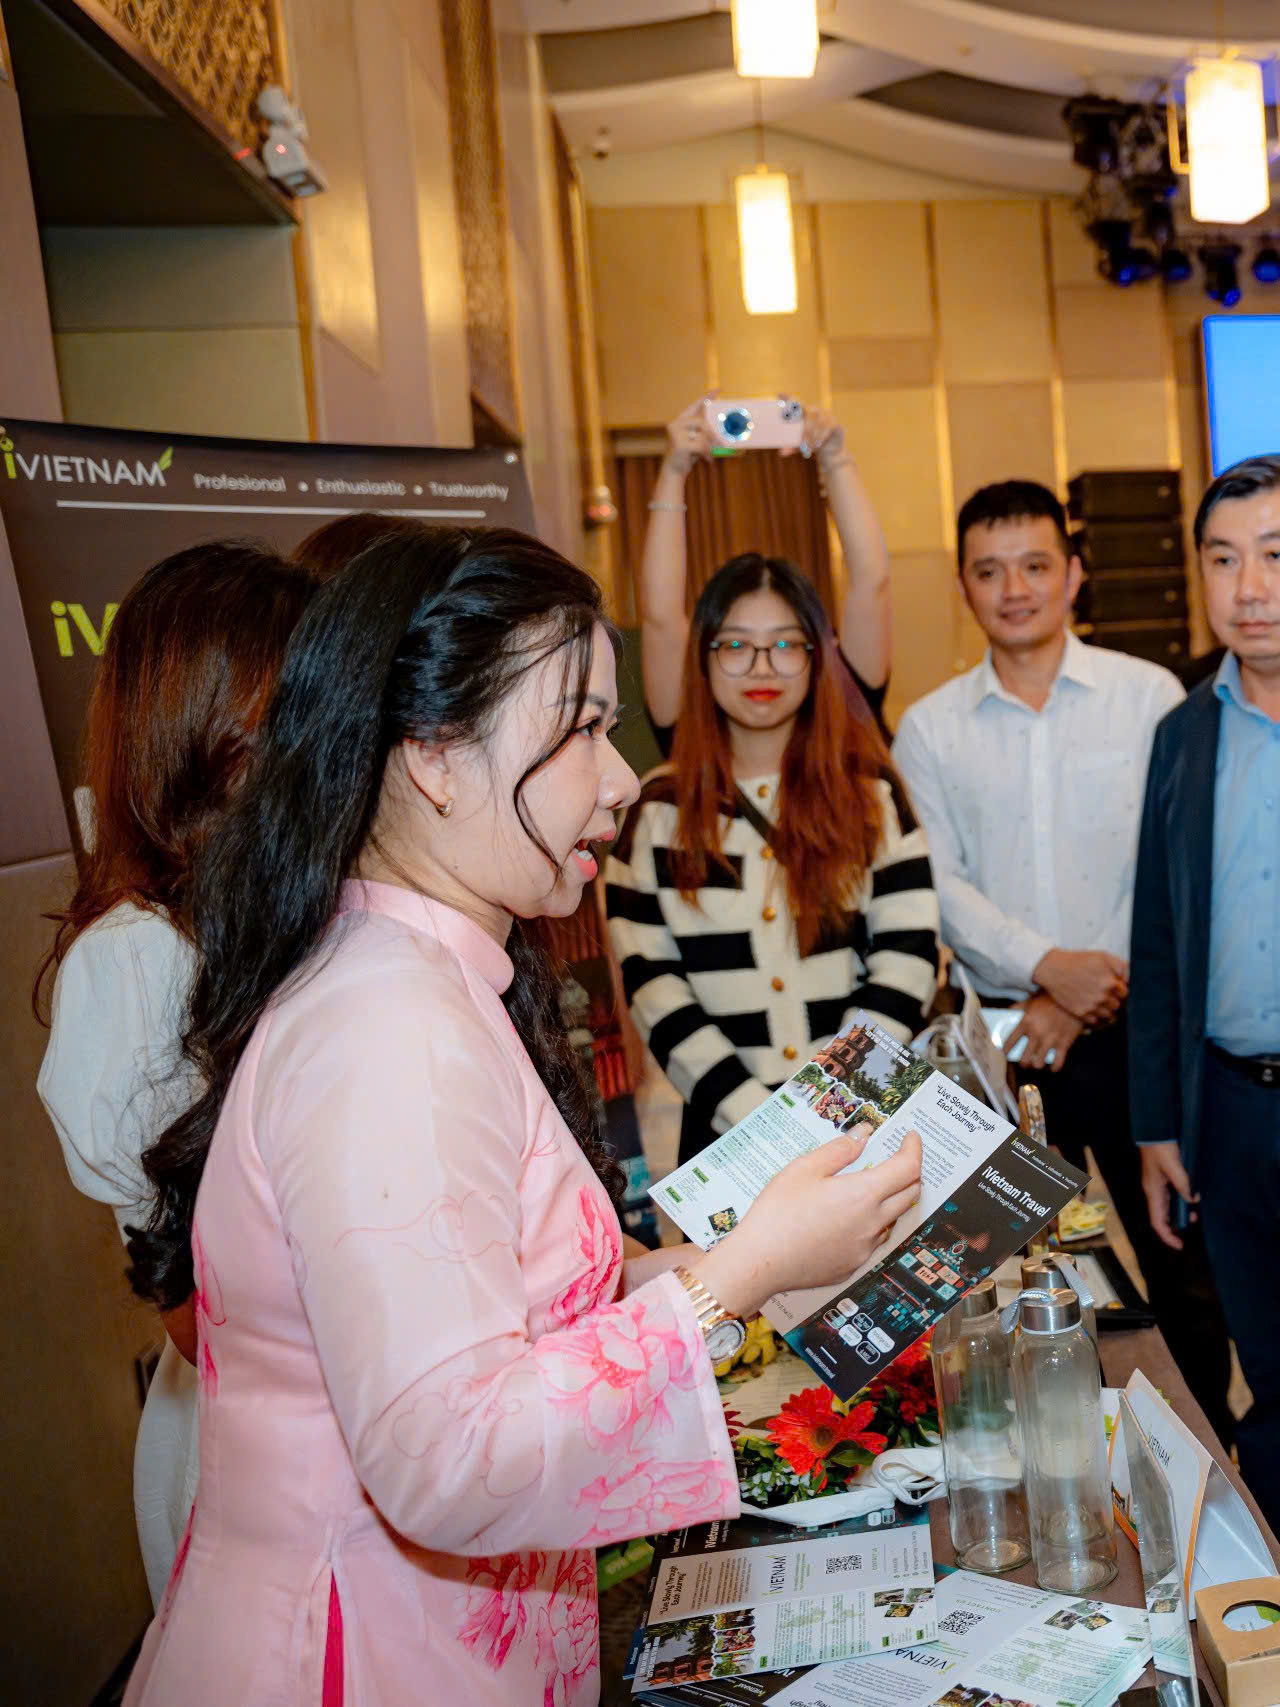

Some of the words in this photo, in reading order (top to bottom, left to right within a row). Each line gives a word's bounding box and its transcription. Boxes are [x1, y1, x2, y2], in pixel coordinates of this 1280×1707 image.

[193, 473, 287, 492] Profesional
[315, 478, 407, 496] Enthusiastic
[428, 481, 509, 502] Trustworthy
[936, 1098, 953, 1113] Each
[949, 1096, 971, 1115] Slowly
[969, 1110, 996, 1133] Through
[981, 1166, 1021, 1199] iVietnam
[1019, 1191, 1051, 1217] Travel
[897, 1645, 955, 1677] iVIETNA
